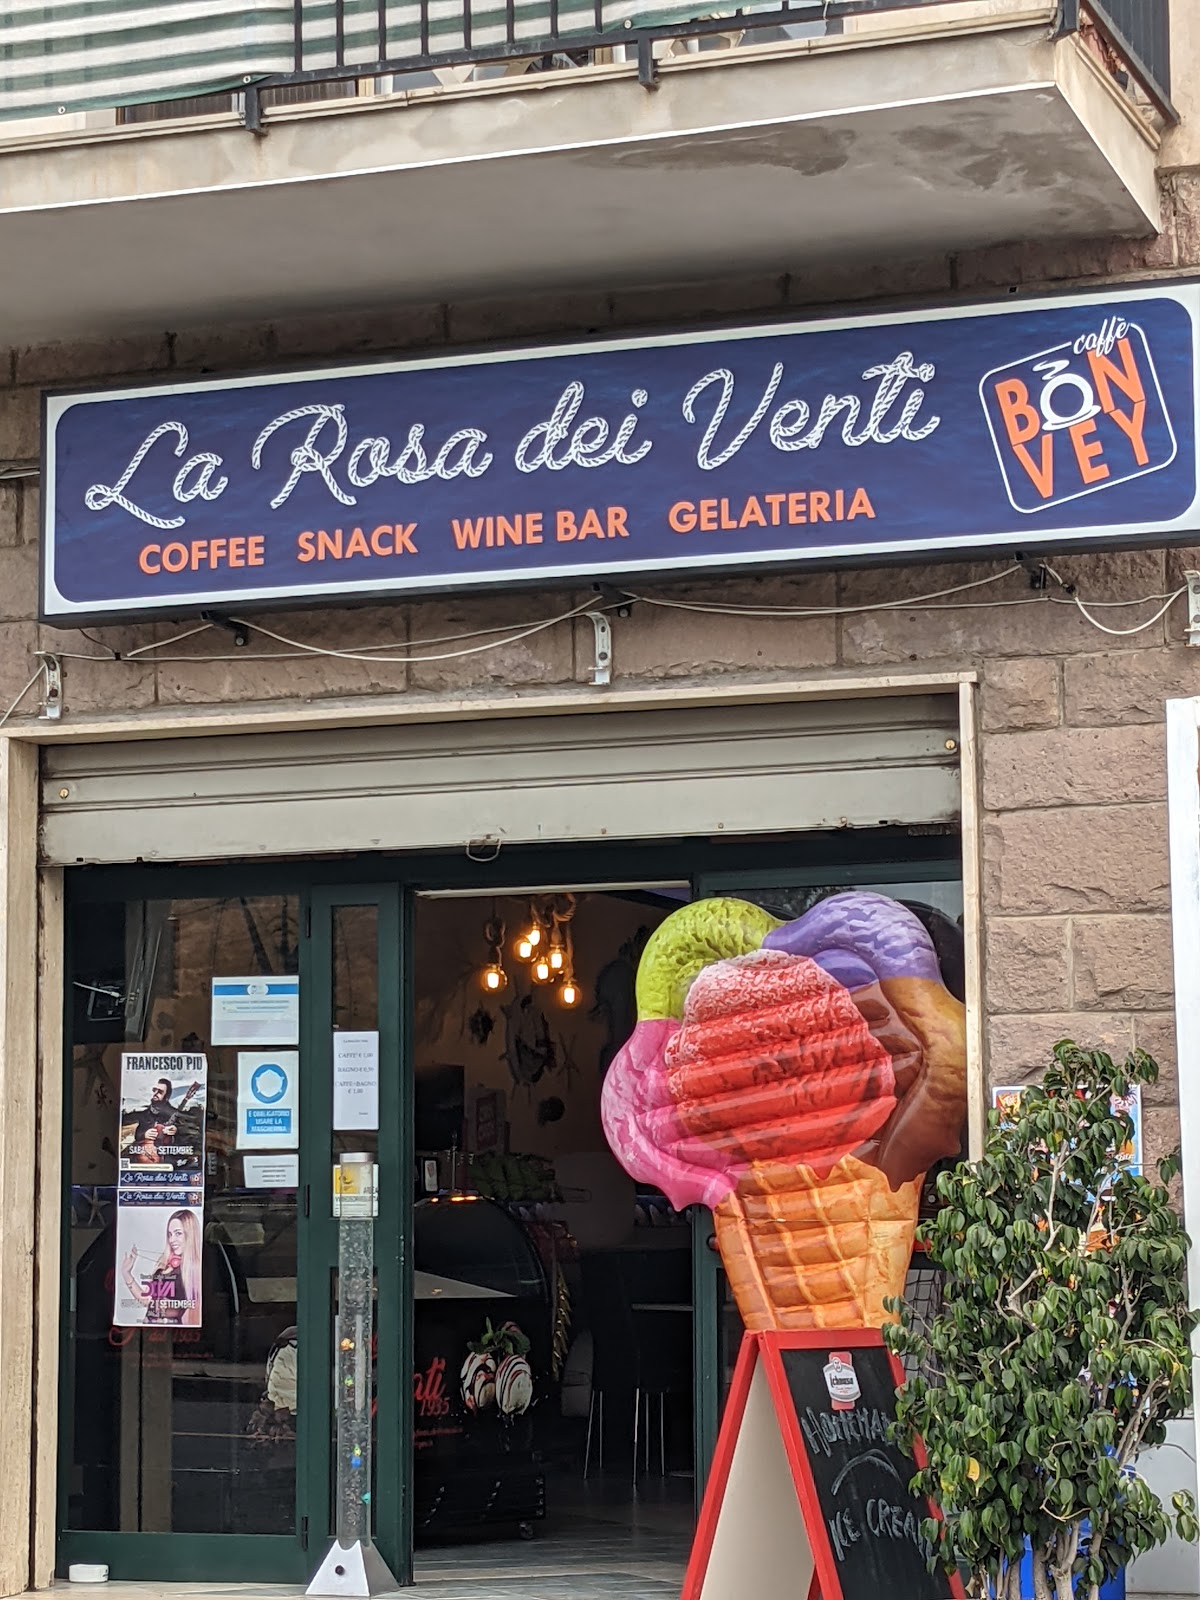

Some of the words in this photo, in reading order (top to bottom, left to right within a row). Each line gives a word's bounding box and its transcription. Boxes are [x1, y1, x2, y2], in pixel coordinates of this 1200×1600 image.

[85, 420, 229, 529] La
[251, 403, 493, 510] Rosa
[515, 381, 653, 473] dei
[682, 351, 941, 471] Venti
[138, 535, 266, 575] COFFEE
[297, 523, 419, 563] SNACK
[452, 513, 543, 550] WINE
[556, 506, 630, 542] BAR
[667, 488, 876, 534] GELATERIA
[127, 1056, 184, 1070] FRANCESCO
[158, 1146, 194, 1155] SETTEMBRE
[159, 1300, 196, 1309] SETTEMBRE
